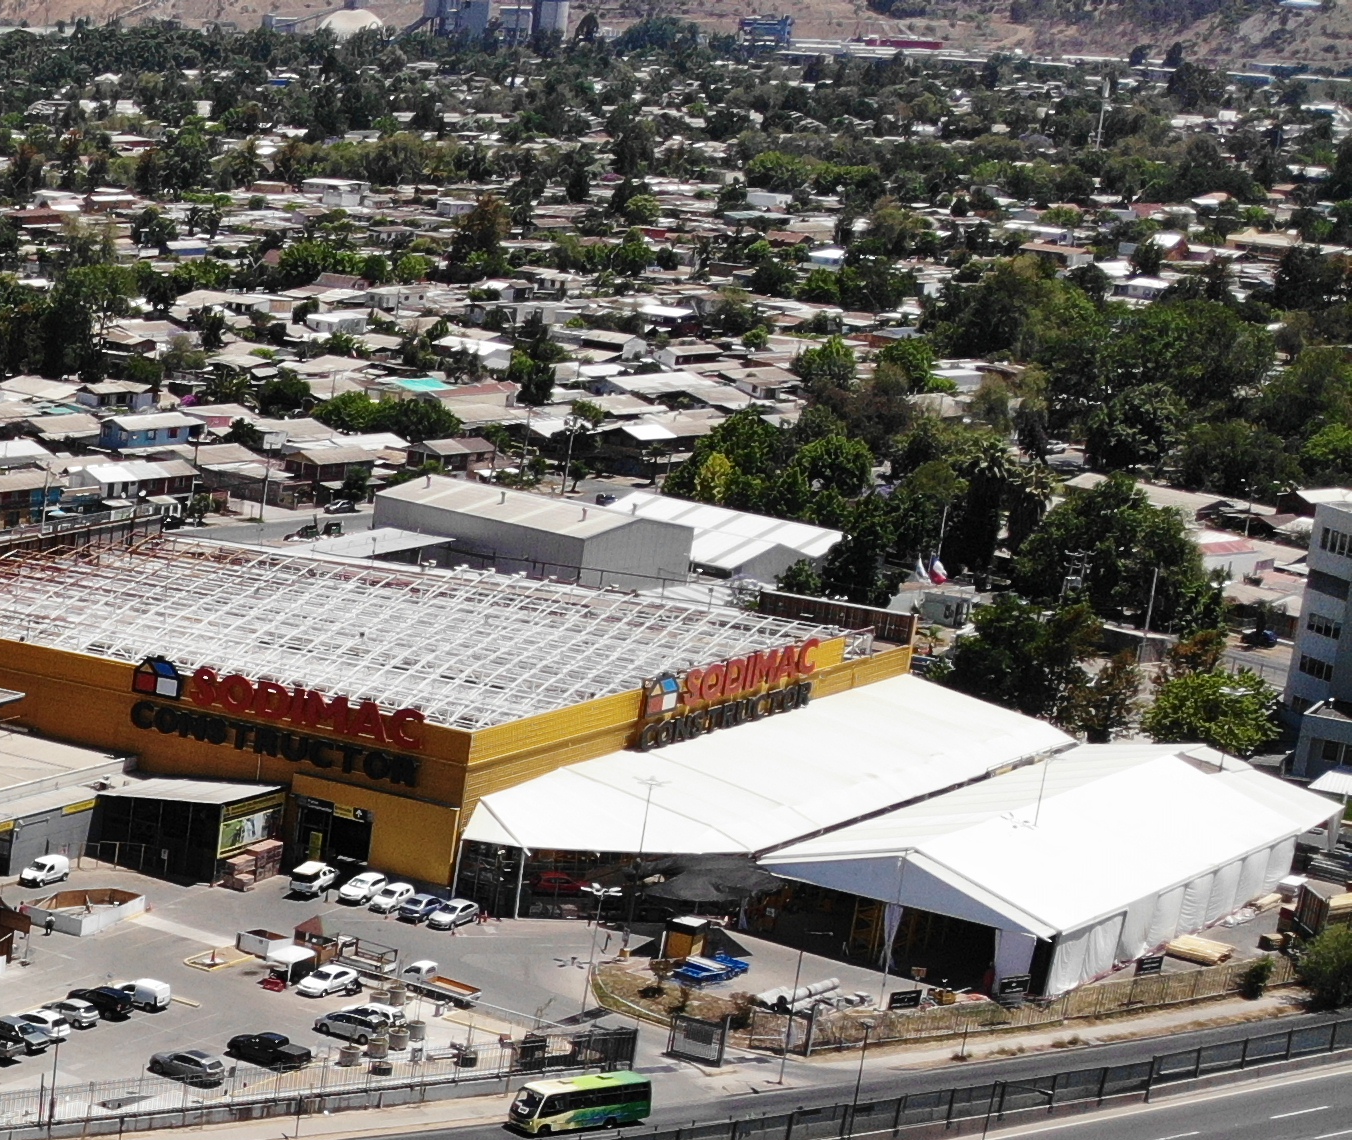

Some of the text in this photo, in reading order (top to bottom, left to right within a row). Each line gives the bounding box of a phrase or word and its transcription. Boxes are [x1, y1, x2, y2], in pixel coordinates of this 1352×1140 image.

[190, 665, 427, 749] SODIMAC
[683, 638, 821, 706] SODIMAC
[131, 700, 418, 787] CONSTRUCTOR
[642, 681, 813, 752] CONSTRUCTOR
